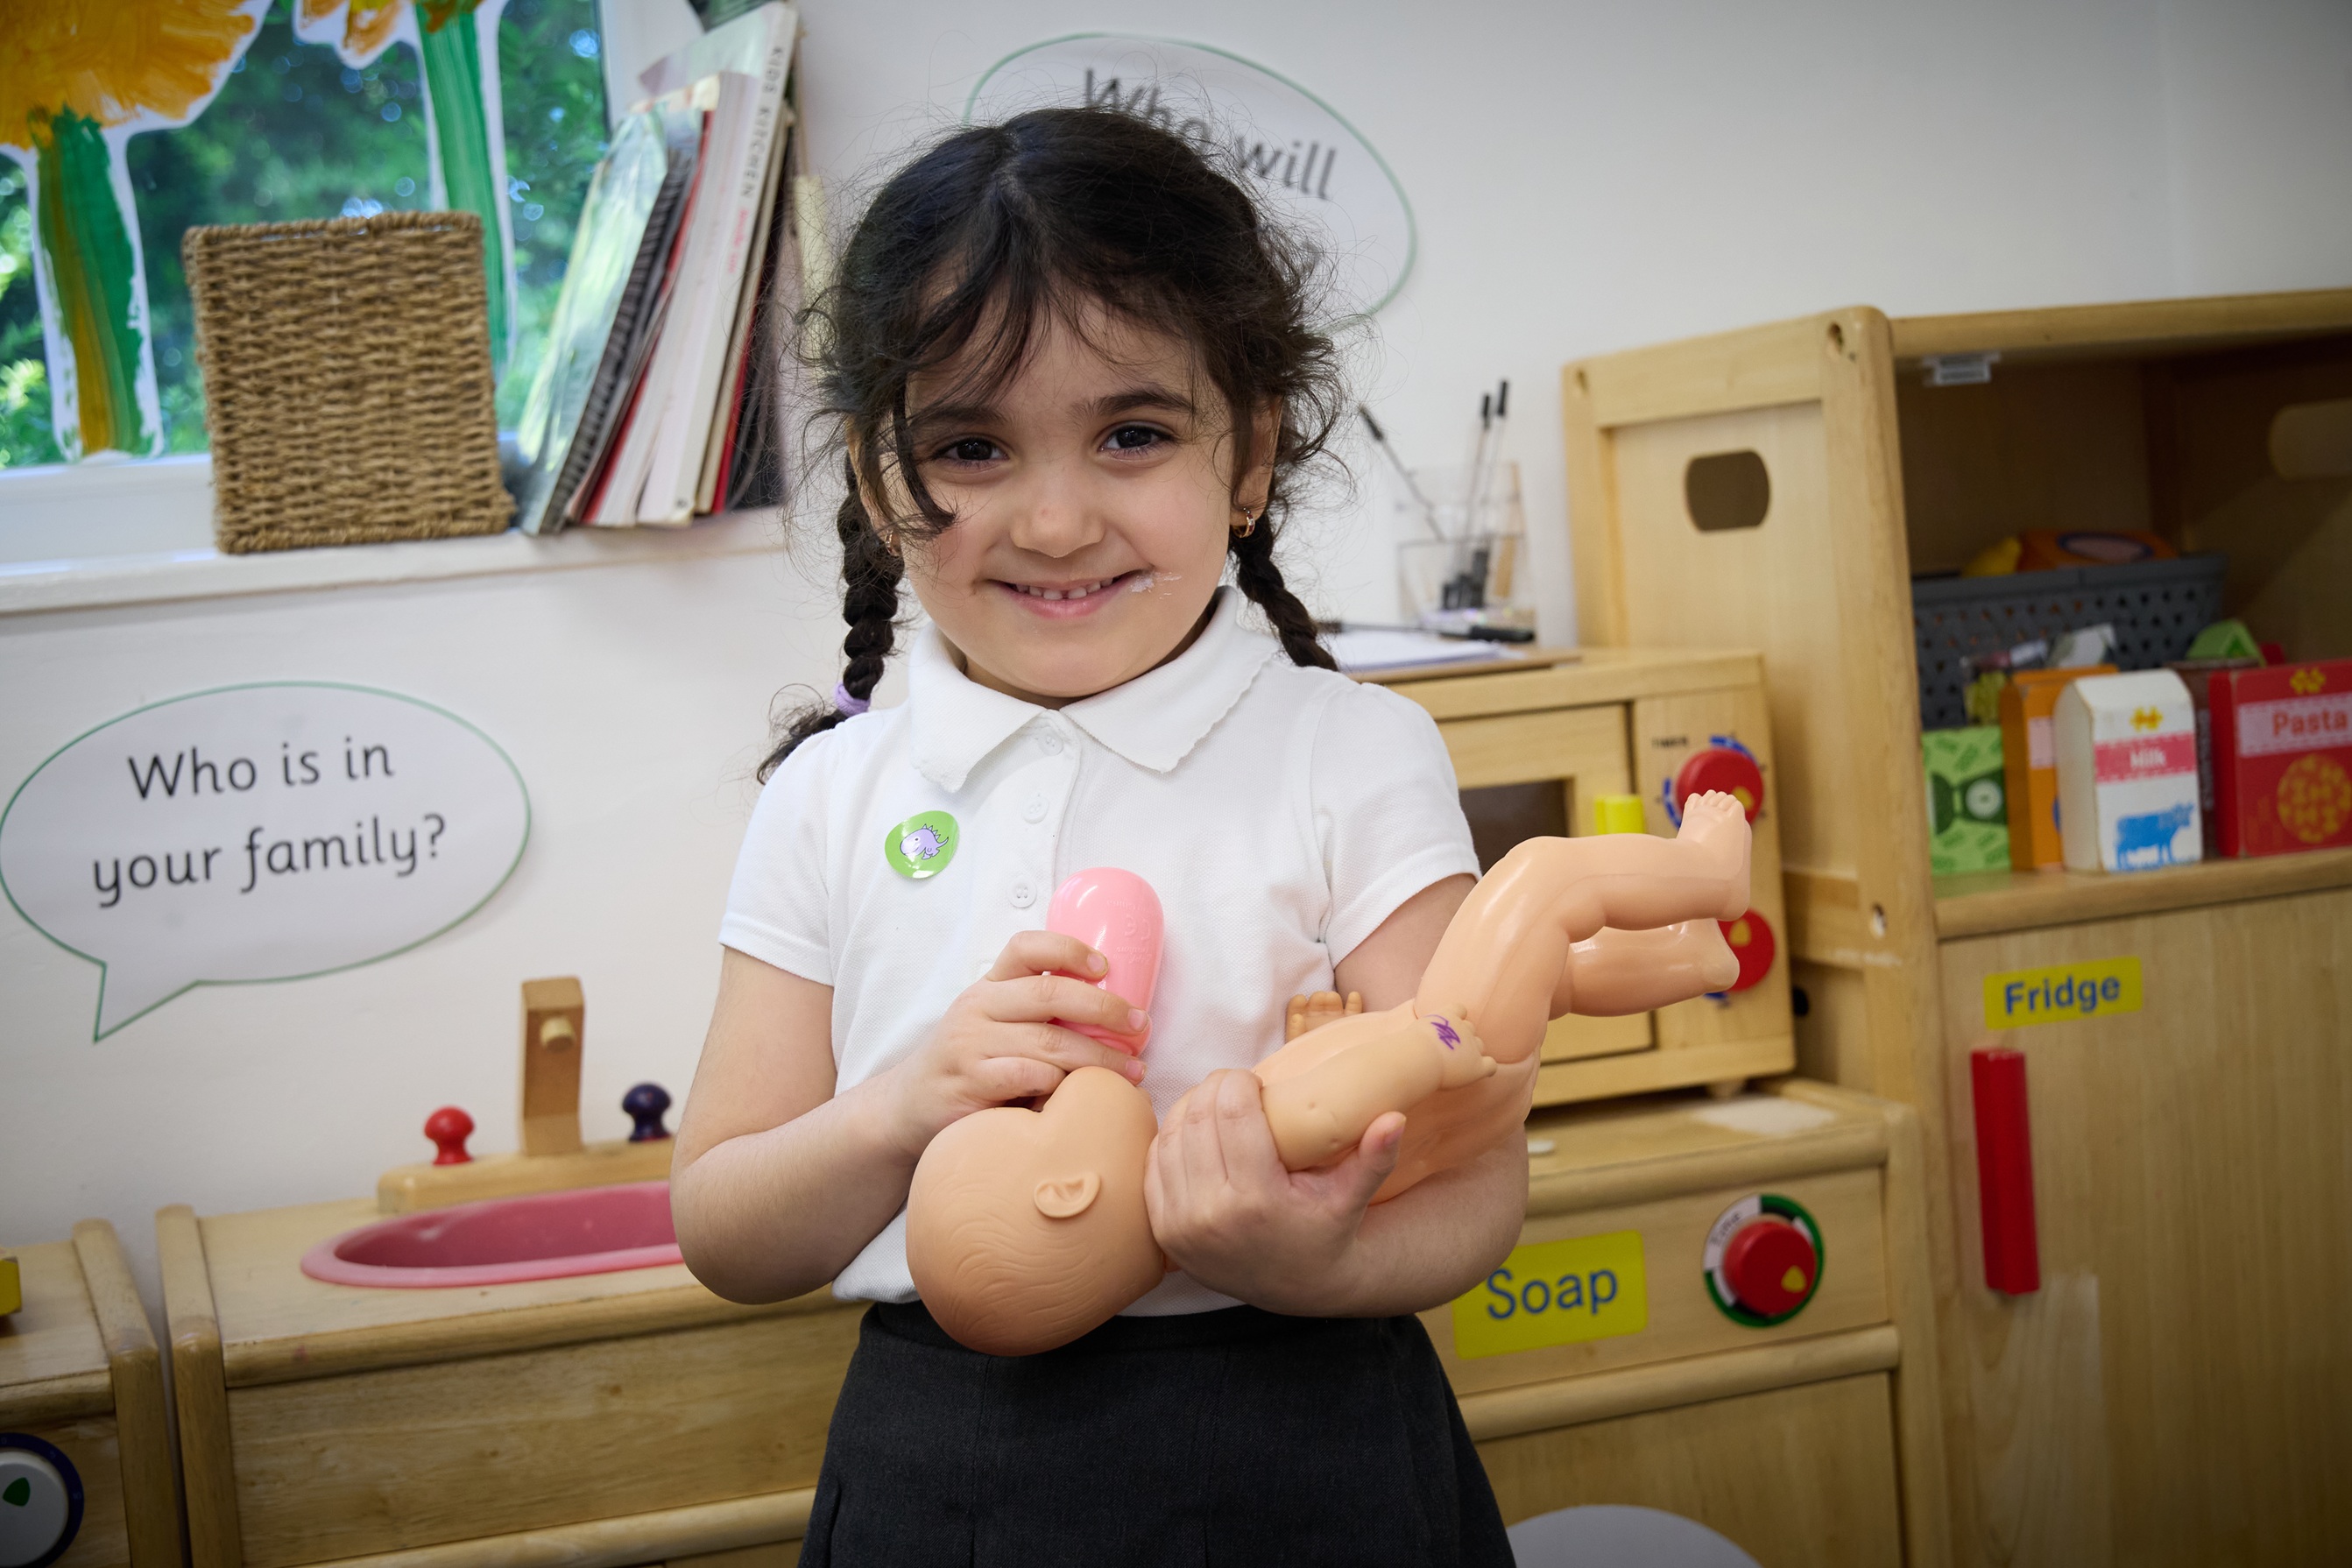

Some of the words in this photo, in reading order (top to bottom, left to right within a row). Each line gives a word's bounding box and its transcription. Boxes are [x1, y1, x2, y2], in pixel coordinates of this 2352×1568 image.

[762, 46, 783, 94] KIDS
[741, 107, 771, 197] KITCHEN
[1236, 137, 1336, 200] will
[2272, 710, 2348, 738] Pasta
[127, 746, 258, 800] Who
[281, 742, 321, 787] is
[344, 736, 395, 780] in
[93, 846, 222, 908] your
[240, 813, 446, 894] family?
[2005, 975, 2121, 1016] Fridge
[1487, 1268, 1619, 1320] Soap
